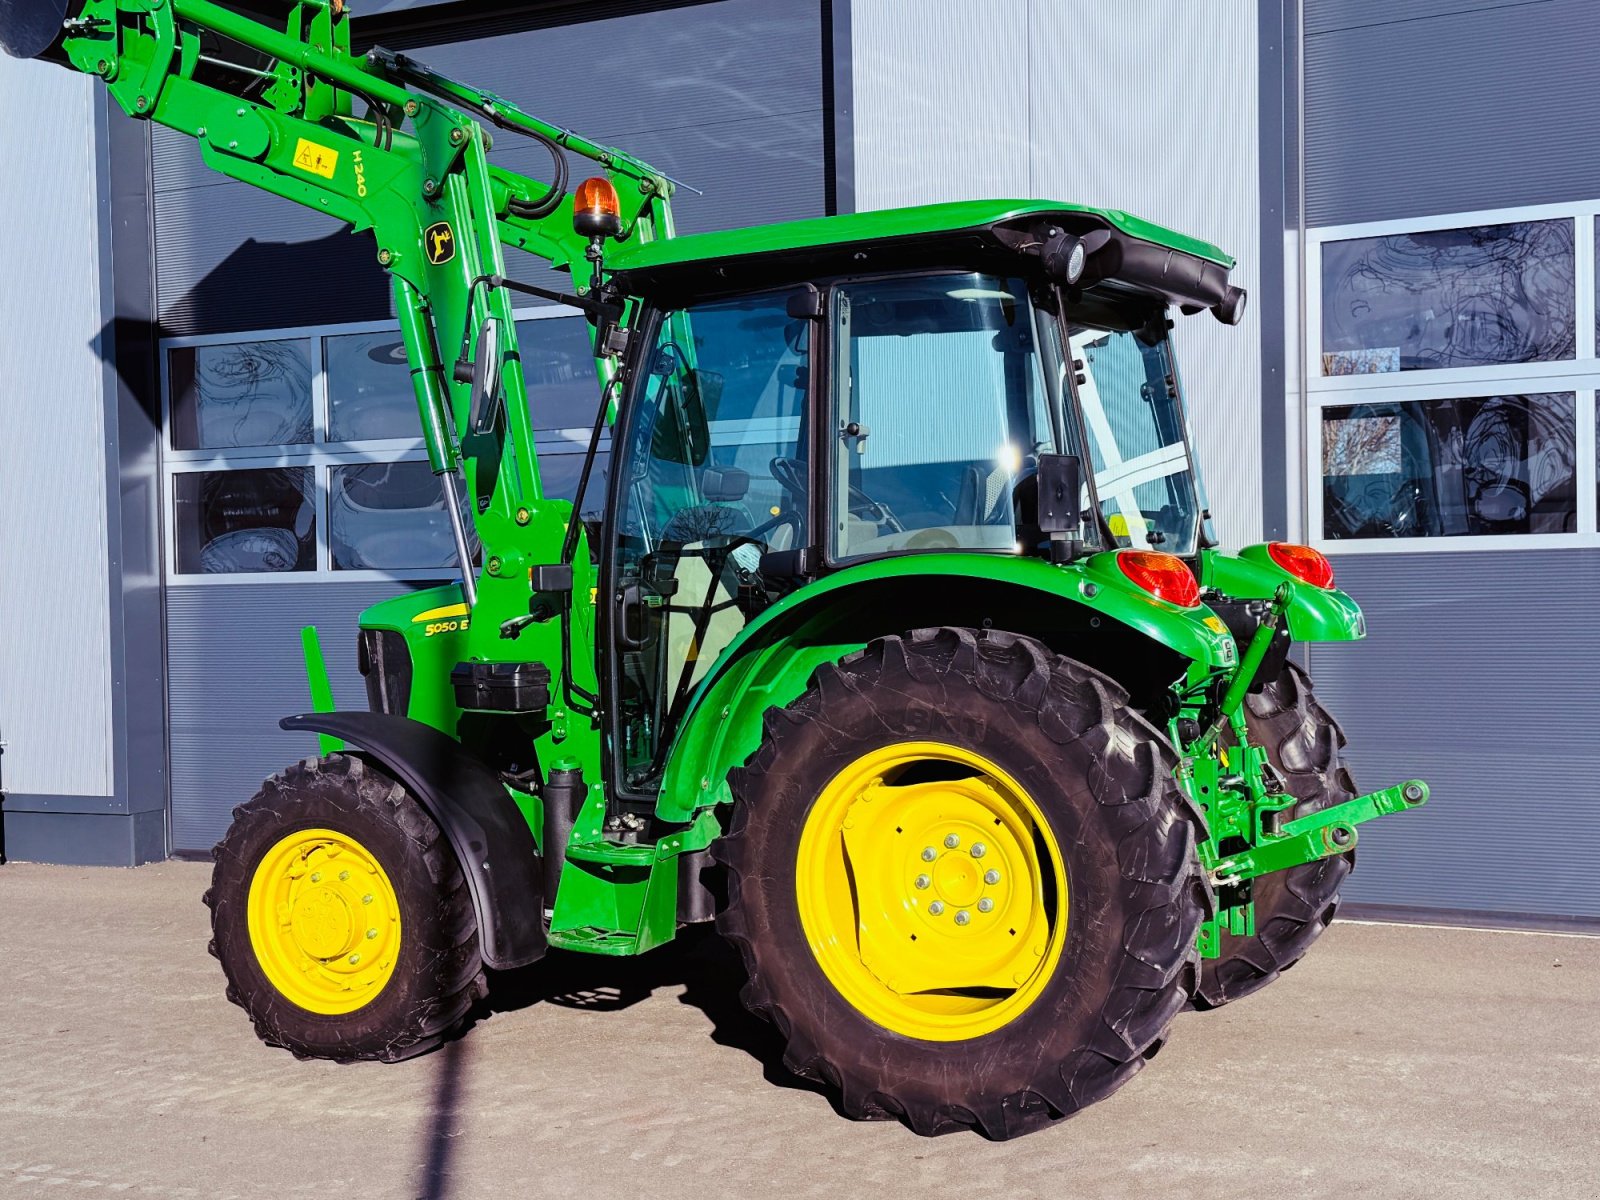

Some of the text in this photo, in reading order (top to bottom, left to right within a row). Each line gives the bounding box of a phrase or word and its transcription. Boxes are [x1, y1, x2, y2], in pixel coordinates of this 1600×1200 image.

[352, 150, 367, 197] H240
[425, 619, 470, 637] 5050 E
[905, 700, 988, 742] BKT
